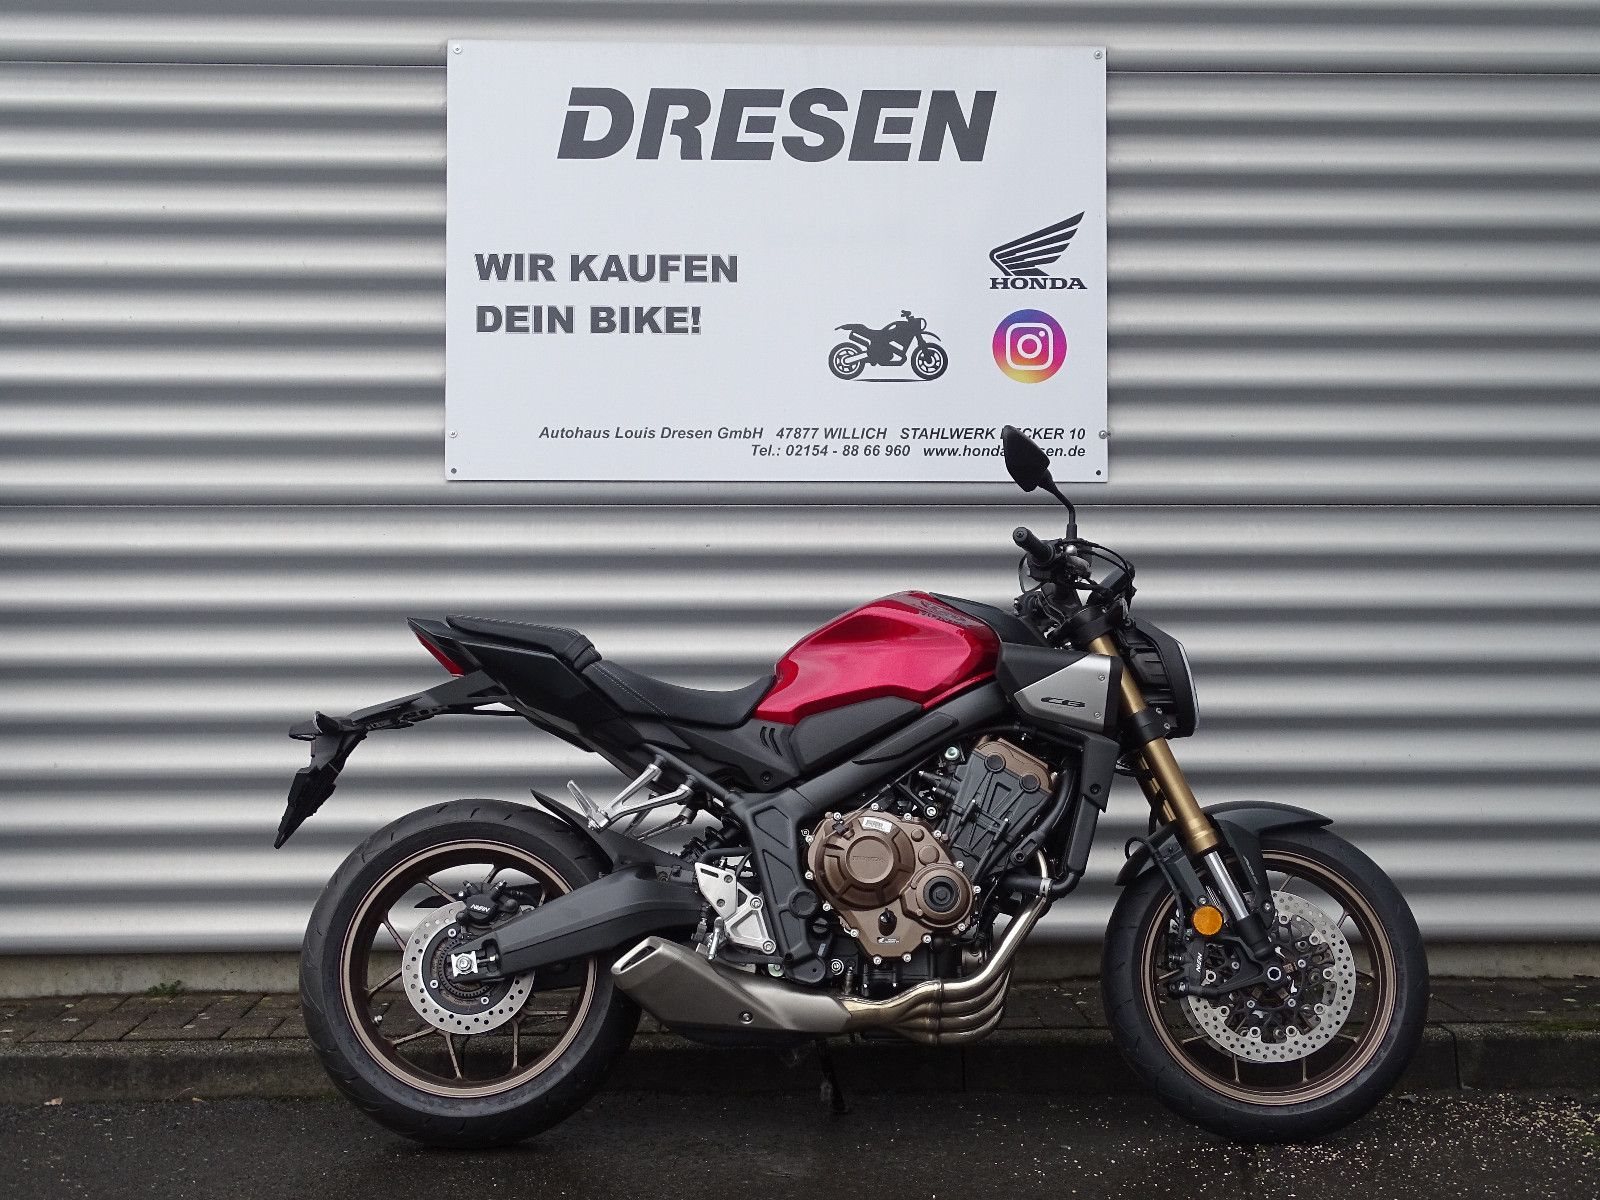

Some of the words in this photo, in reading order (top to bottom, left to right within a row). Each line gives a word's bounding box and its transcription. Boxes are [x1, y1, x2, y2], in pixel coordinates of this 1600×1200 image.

[556, 86, 998, 163] DRESEN
[474, 253, 556, 282] WIR
[570, 254, 738, 283] KAUFEN
[989, 277, 1088, 290] HONDA
[476, 305, 574, 334] DEIN
[591, 305, 702, 334] BIKE!
[538, 426, 611, 439] Autohaus
[614, 426, 656, 439] Louis
[660, 426, 713, 439] Dresen
[717, 426, 764, 439] GmbH
[775, 427, 820, 440] 47877
[824, 427, 888, 440] WILLICH
[899, 427, 997, 440] STAHLWERK
[1069, 427, 1086, 440] 10
[751, 444, 781, 457] Tel.:
[785, 444, 829, 457] 02154
[842, 444, 860, 457] 88
[863, 444, 881, 457] 66
[884, 444, 911, 457] 960
